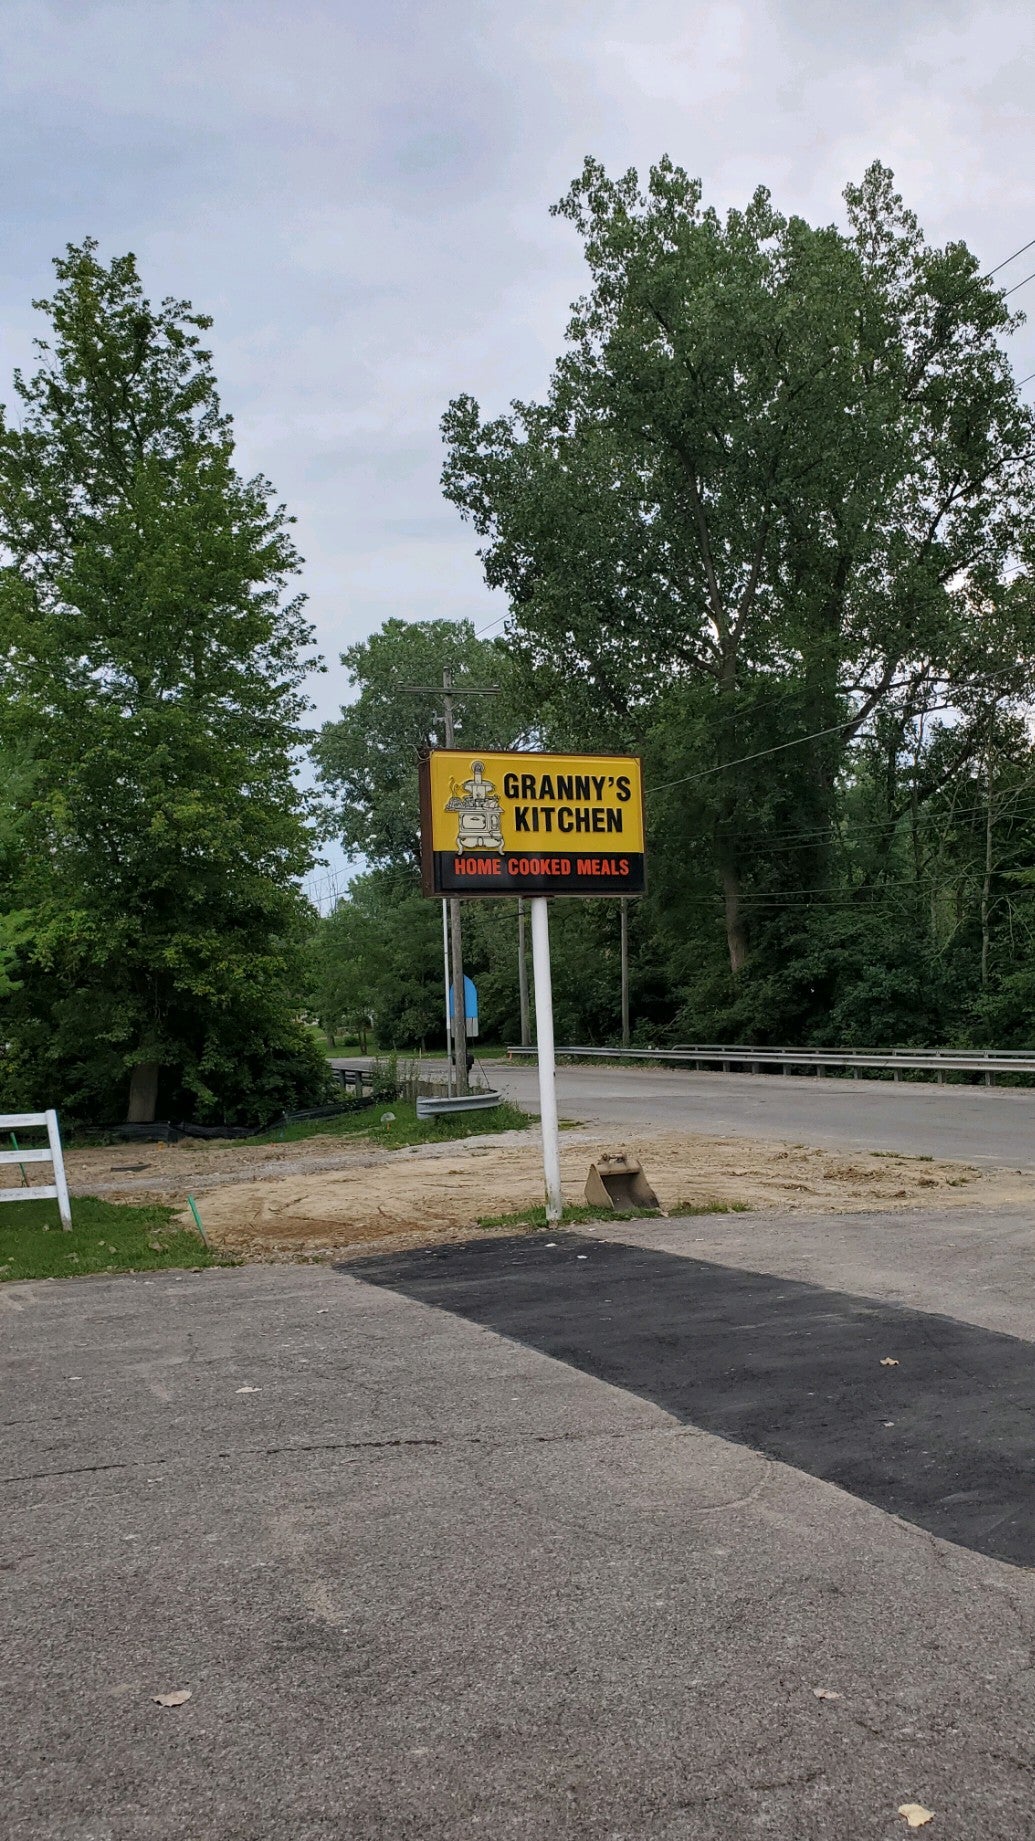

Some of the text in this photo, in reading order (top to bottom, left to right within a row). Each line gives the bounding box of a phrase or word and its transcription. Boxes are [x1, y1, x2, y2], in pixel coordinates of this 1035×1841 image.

[504, 773, 631, 802] GRANNY'S
[515, 806, 623, 833] KITCHEN
[454, 858, 629, 876] HOME COOKED MEALS
